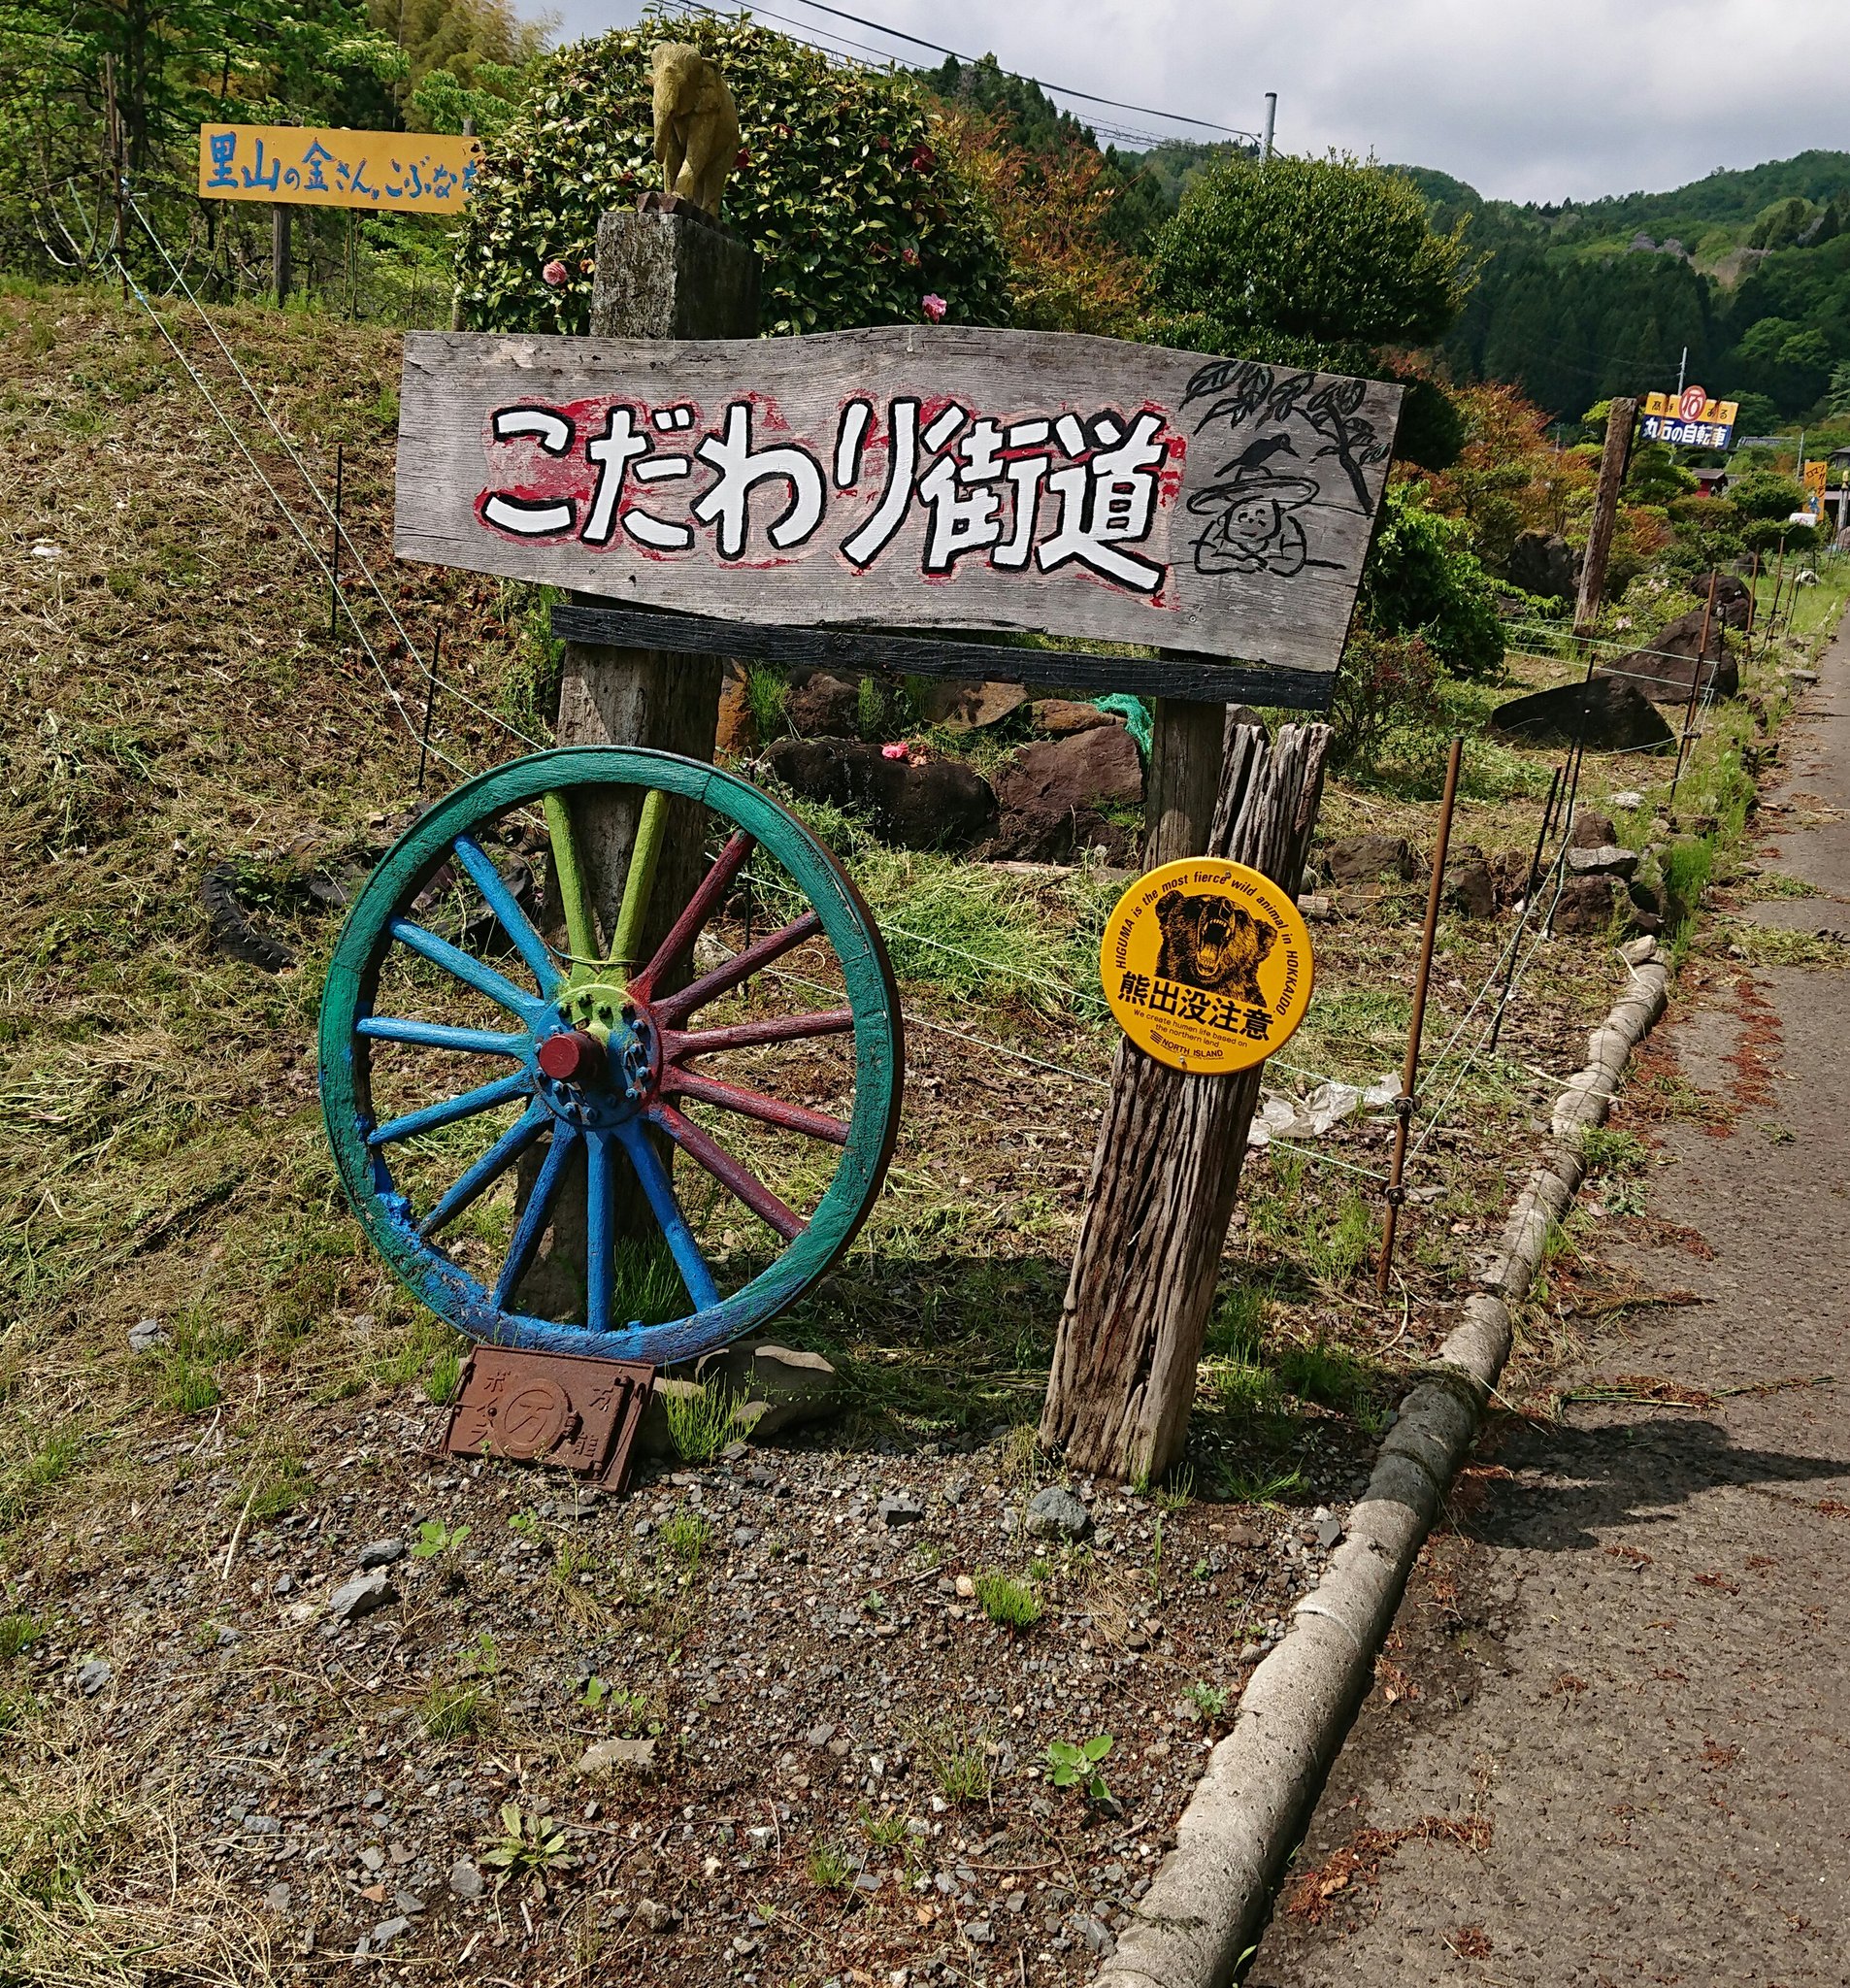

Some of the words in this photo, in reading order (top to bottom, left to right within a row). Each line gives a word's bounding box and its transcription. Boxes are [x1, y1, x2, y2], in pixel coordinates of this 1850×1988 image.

[1642, 416, 1727, 447] 丸石の自転車
[481, 394, 1168, 594] こだわり街道
[1115, 918, 1136, 970] HIGUMA
[1131, 906, 1142, 918] is
[1141, 889, 1159, 906] the
[1162, 875, 1188, 892] most
[1194, 871, 1227, 884] fierce
[1231, 878, 1258, 897] wild
[1256, 896, 1289, 929] animal
[1281, 933, 1293, 944] in
[1118, 971, 1274, 1042] 熊出没注意
[1134, 1009, 1144, 1018] We
[1146, 1013, 1172, 1026] create
[1173, 1020, 1198, 1033] human
[1212, 1032, 1237, 1045] based
[1155, 1024, 1168, 1033] the
[1169, 1029, 1203, 1043] northern
[1162, 1038, 1191, 1055] NORTH
[1193, 1049, 1224, 1058] ISLAND
